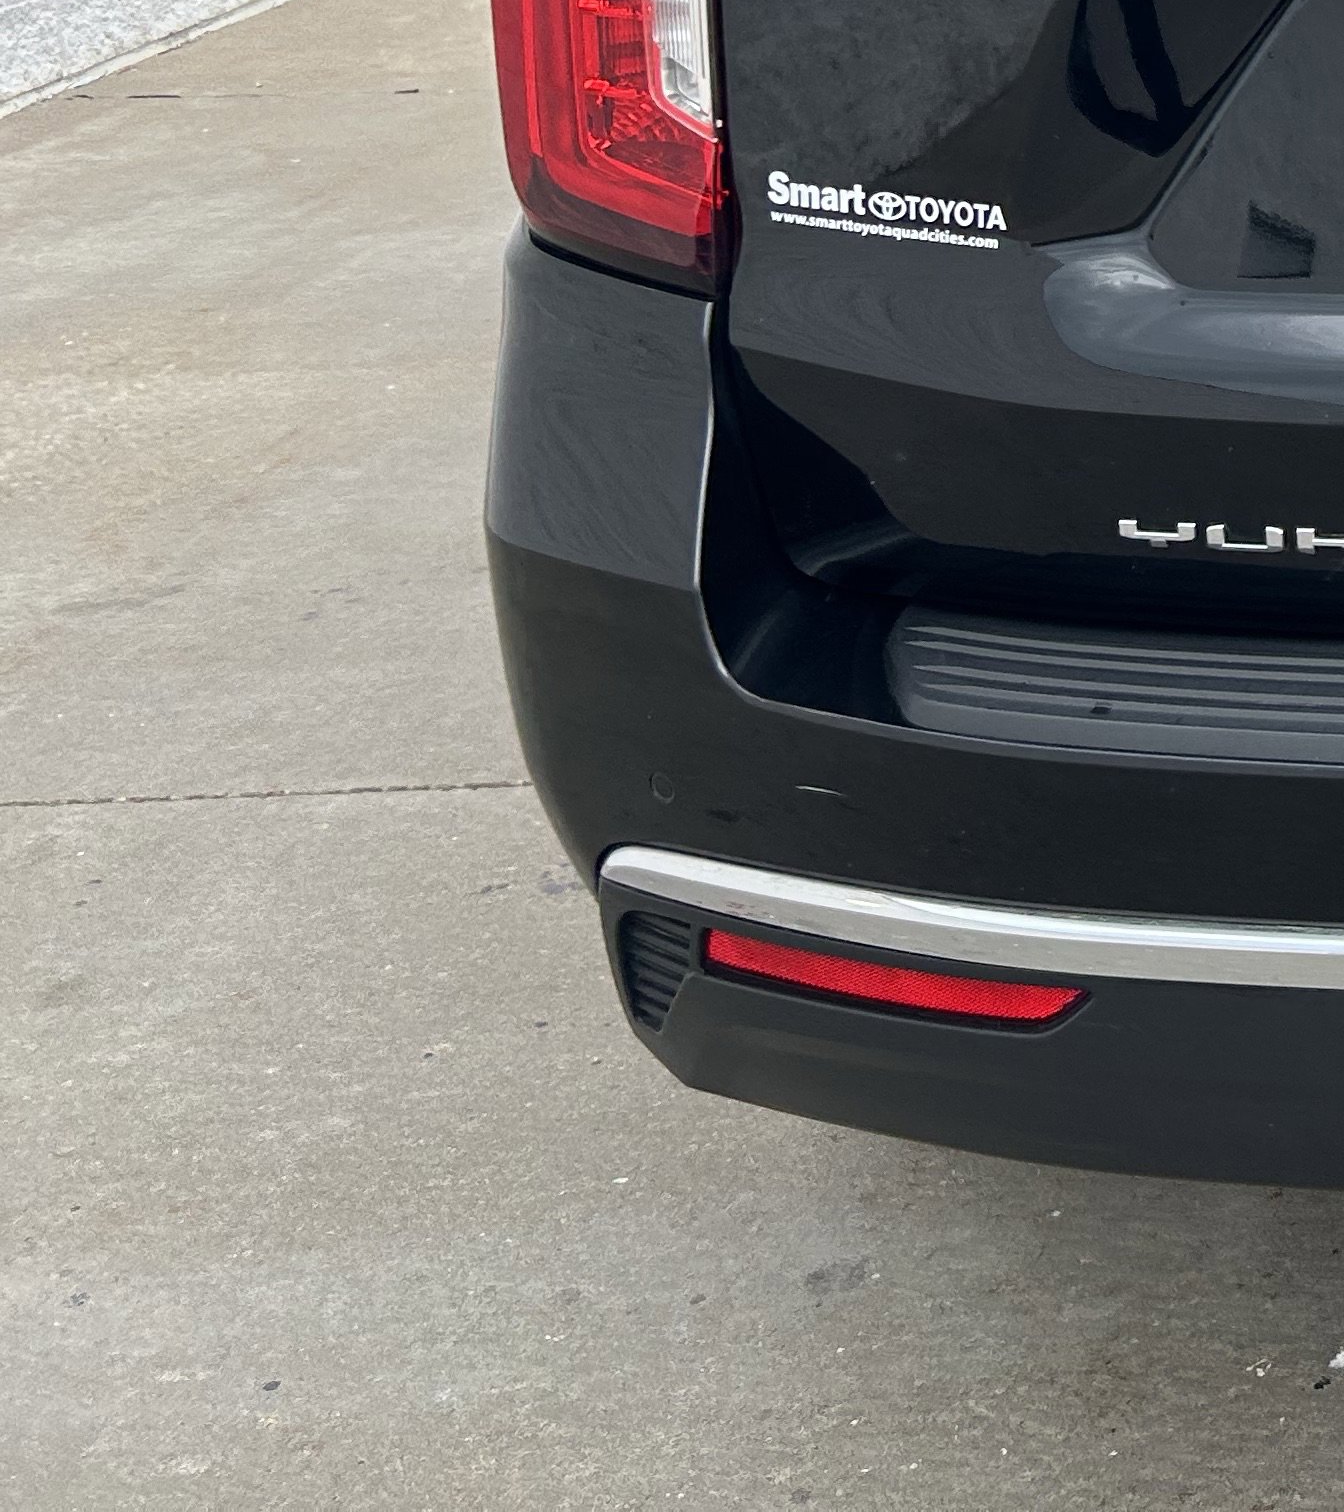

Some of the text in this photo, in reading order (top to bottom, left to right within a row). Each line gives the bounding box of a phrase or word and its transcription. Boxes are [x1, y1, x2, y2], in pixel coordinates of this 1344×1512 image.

[767, 170, 1008, 231] Smart TOYOTA
[770, 210, 999, 250] www.smarttoyotaquadcities.com
